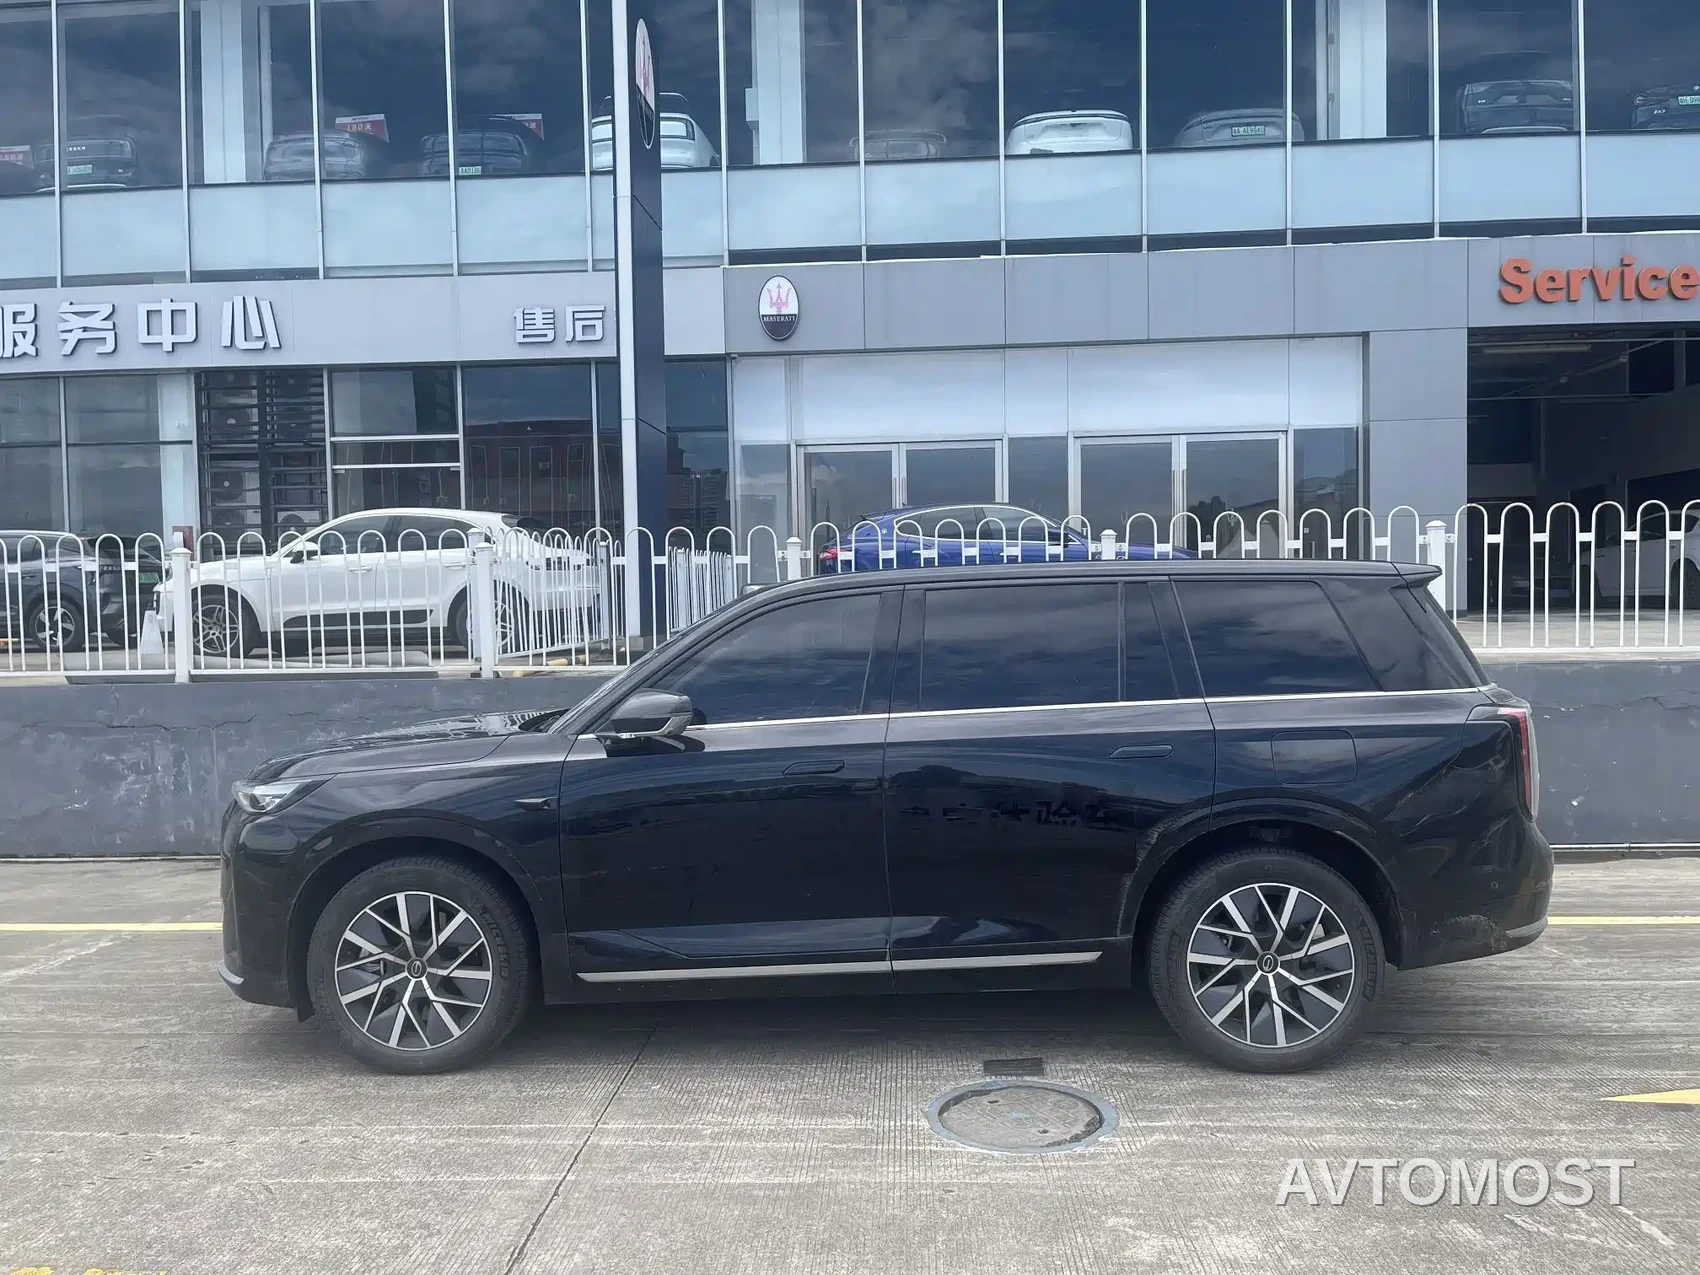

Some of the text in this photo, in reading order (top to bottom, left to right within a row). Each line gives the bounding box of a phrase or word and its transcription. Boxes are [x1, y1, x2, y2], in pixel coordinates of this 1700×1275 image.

[1498, 254, 1700, 304] Service
[0, 296, 282, 358] 服务中心
[514, 305, 606, 344] 售后
